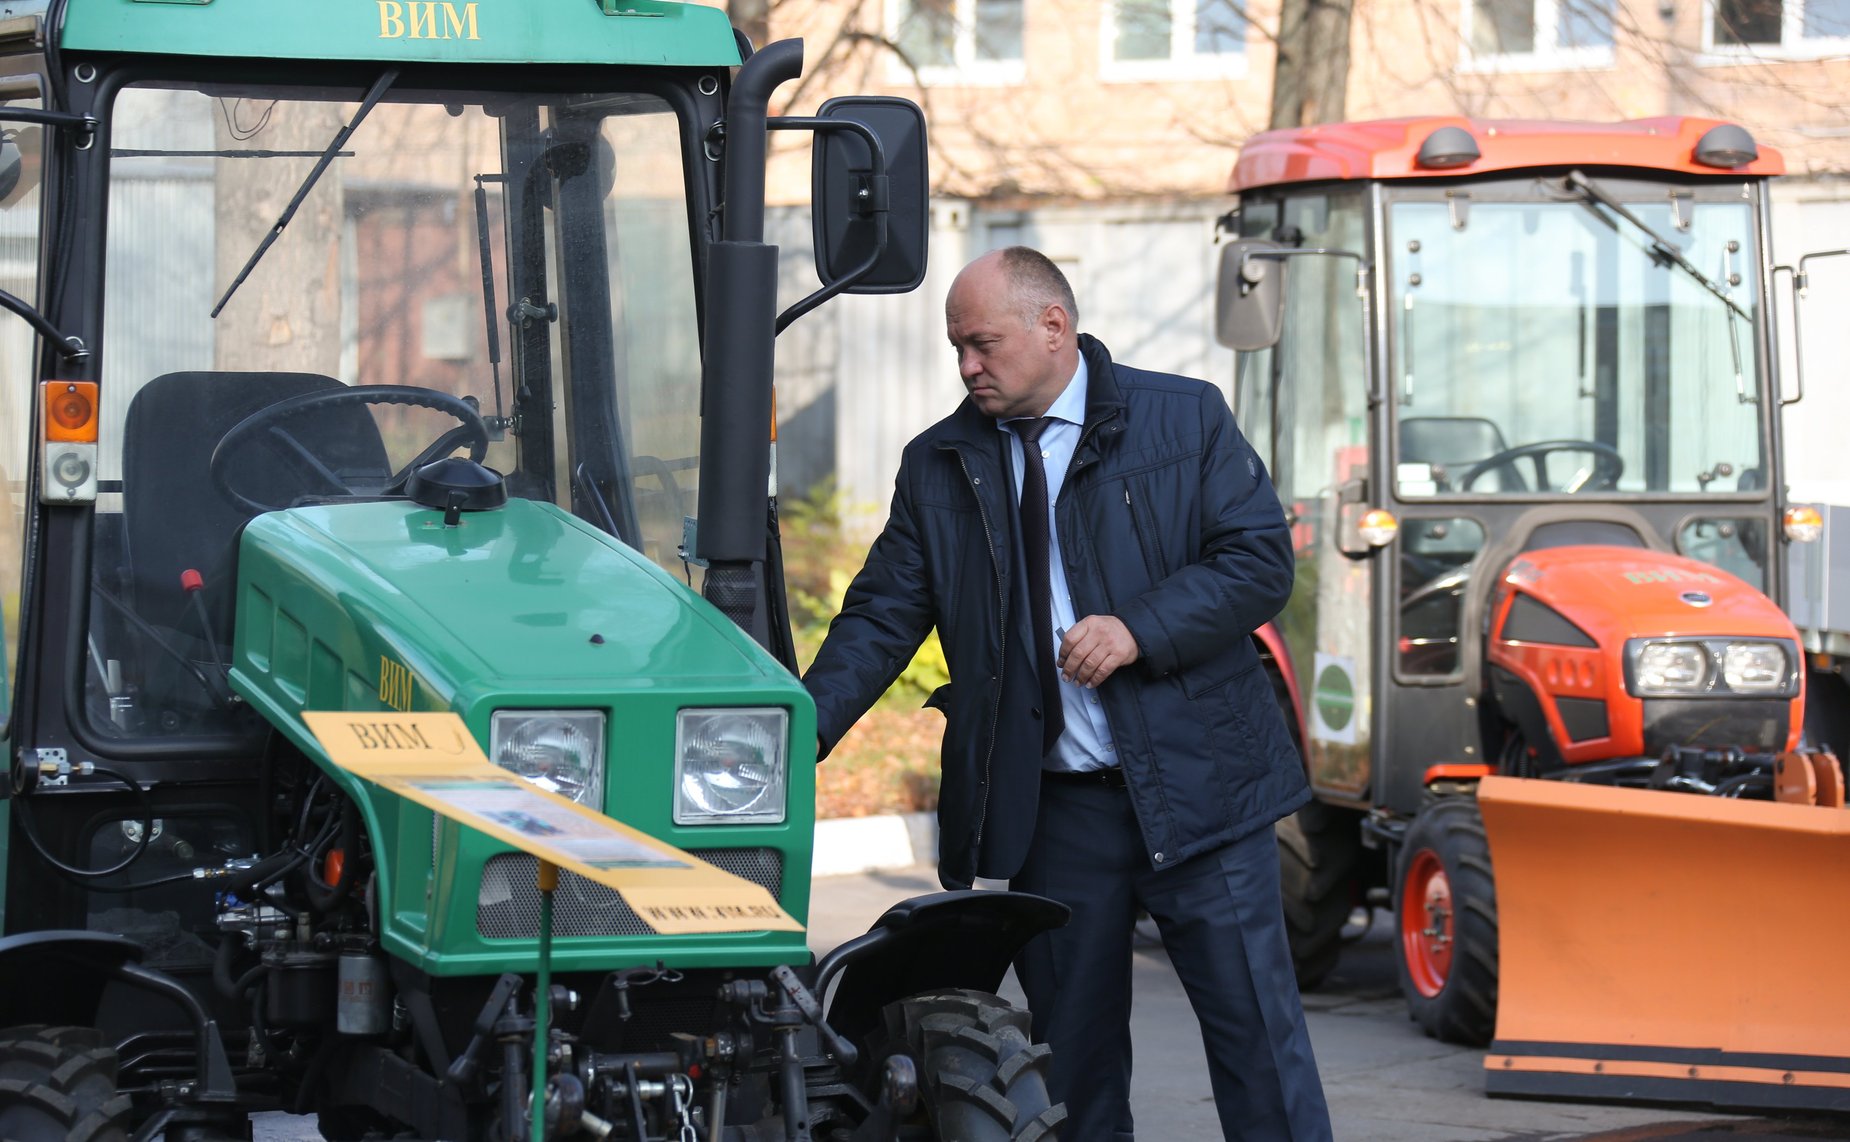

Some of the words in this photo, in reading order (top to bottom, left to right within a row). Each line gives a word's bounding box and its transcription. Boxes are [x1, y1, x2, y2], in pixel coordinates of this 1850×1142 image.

[376, 0, 480, 40] ВИМ
[380, 654, 414, 712] ВИМ
[347, 722, 432, 750] ВИМ
